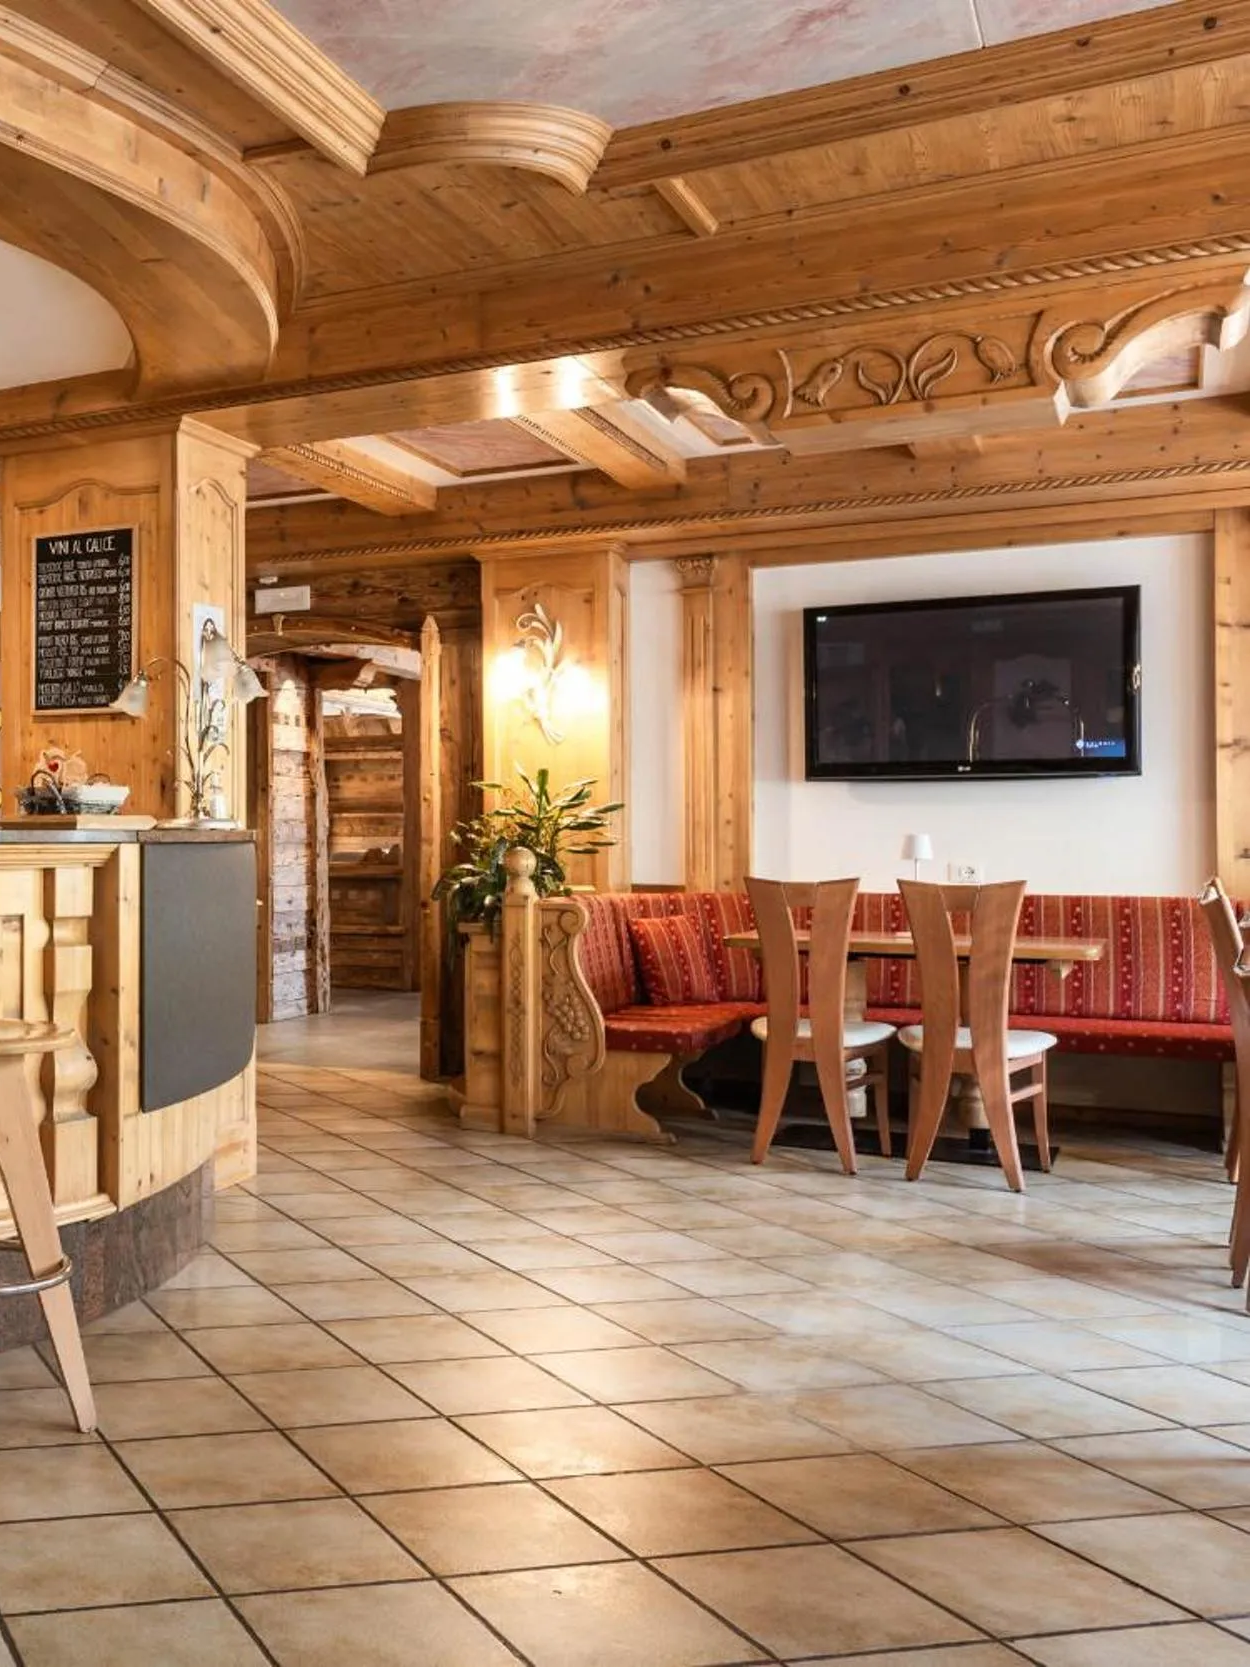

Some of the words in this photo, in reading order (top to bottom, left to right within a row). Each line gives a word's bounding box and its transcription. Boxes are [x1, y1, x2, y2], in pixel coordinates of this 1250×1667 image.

[48, 540, 69, 555] VINI
[72, 539, 83, 554] AL
[86, 535, 116, 553] CALICE
